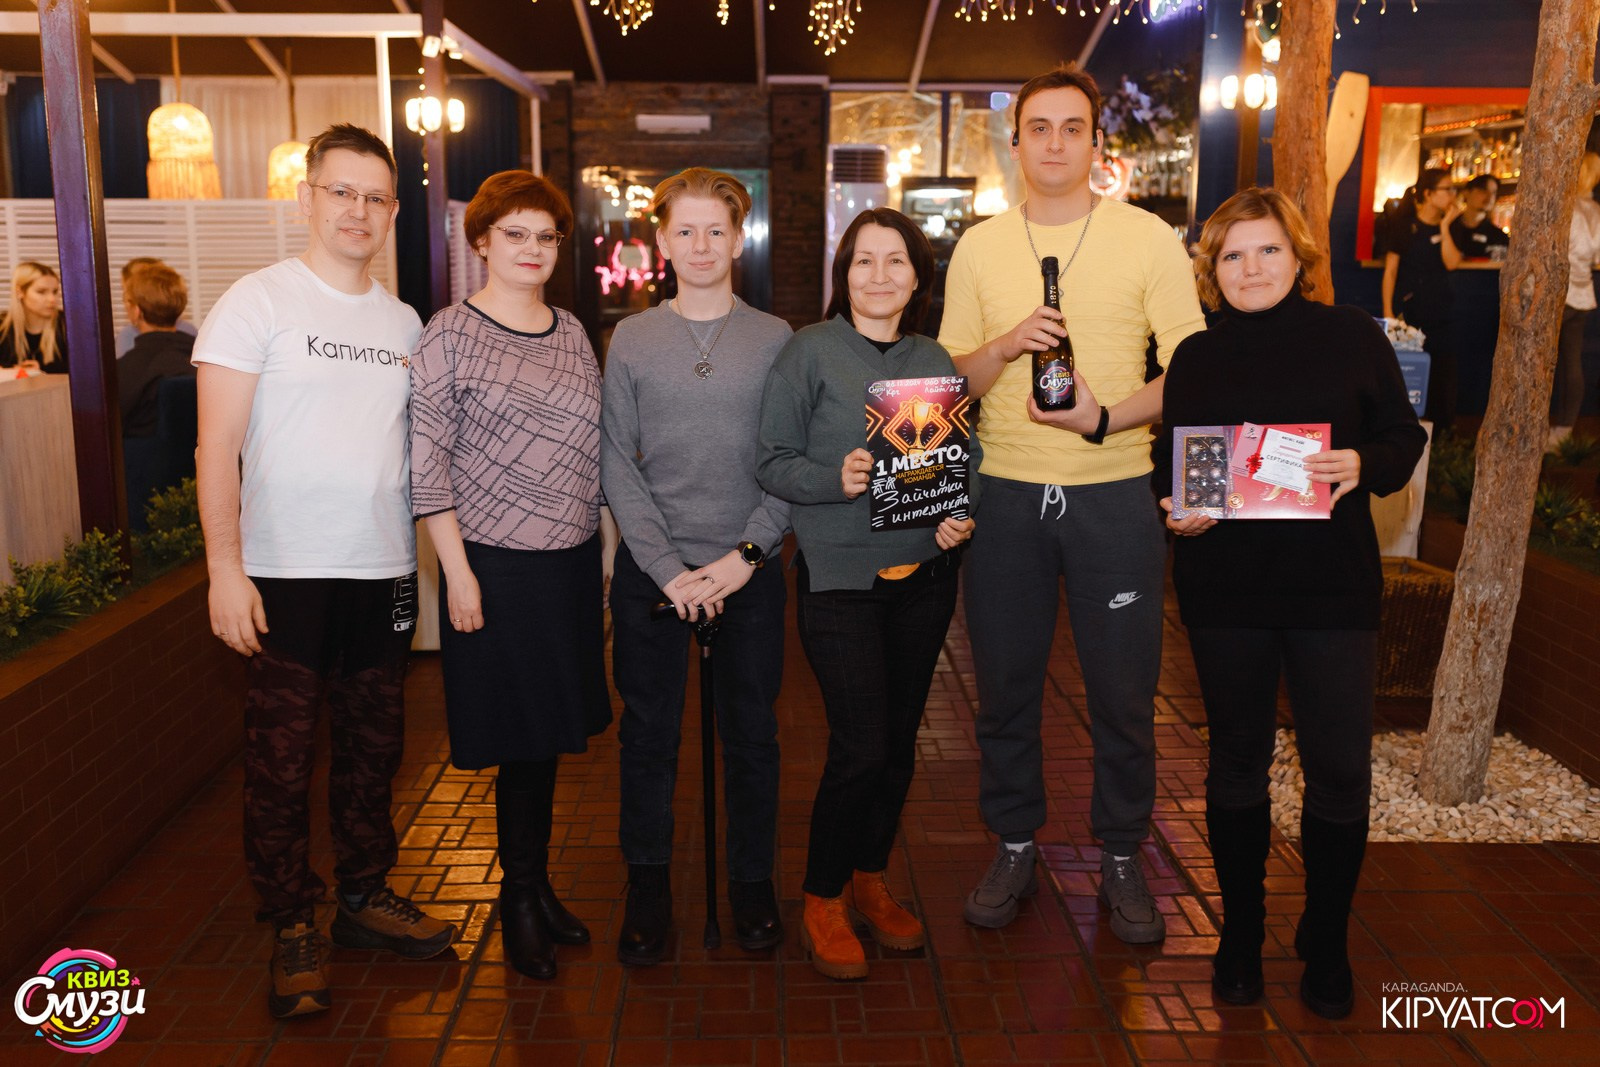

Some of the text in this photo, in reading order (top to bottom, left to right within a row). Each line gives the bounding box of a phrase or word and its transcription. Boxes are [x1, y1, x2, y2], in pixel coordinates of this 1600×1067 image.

[1040, 374, 1074, 389] Смузи
[877, 444, 963, 477] 1 МЕСТО
[1266, 454, 1305, 469] СЕРТИФИКА
[895, 464, 945, 479] НАГРАЖДАЕТСЯ
[904, 474, 936, 484] КОМАНДА
[1113, 591, 1137, 602] NIKE
